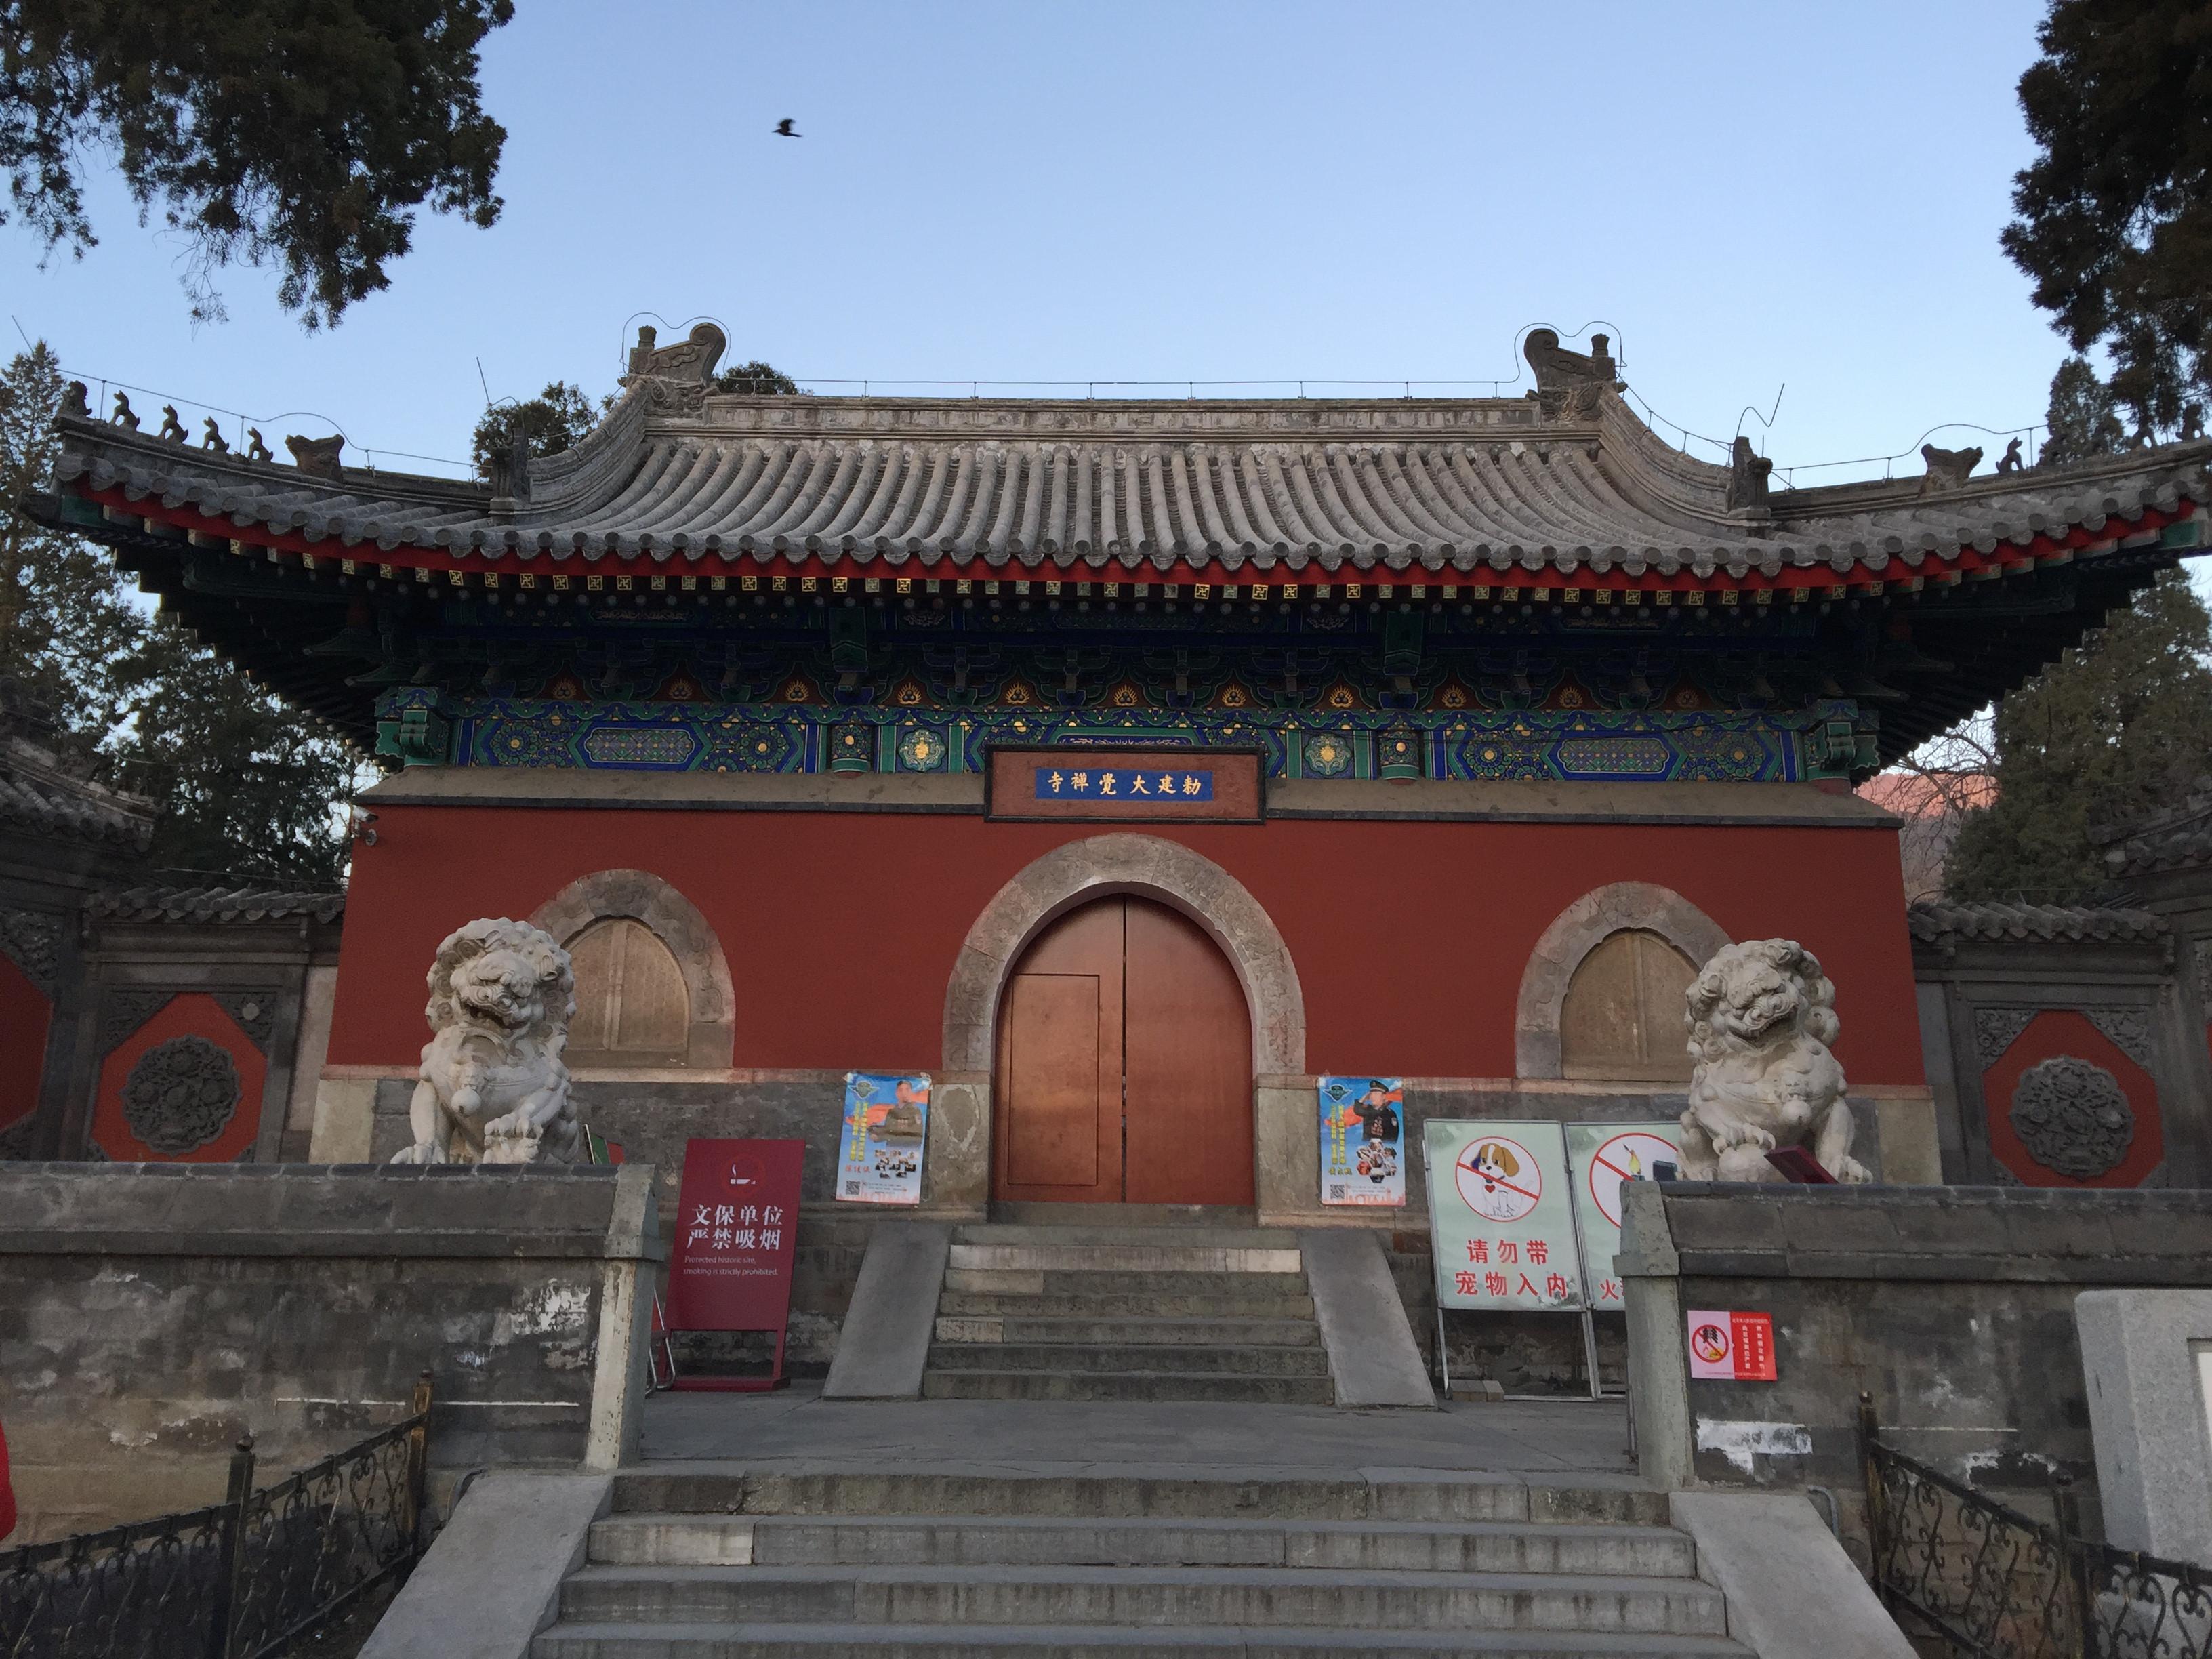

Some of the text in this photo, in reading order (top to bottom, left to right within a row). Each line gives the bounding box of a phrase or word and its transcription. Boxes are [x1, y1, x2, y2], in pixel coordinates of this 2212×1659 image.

[690, 1204, 784, 1226] 文保单位
[687, 1228, 781, 1250] 严禁吸烟
[684, 1256, 716, 1264] Protected
[1467, 1239, 1549, 1265] 请勿带
[1455, 1270, 1568, 1297] 宠物入内
[1599, 1279, 1626, 1300] 火
